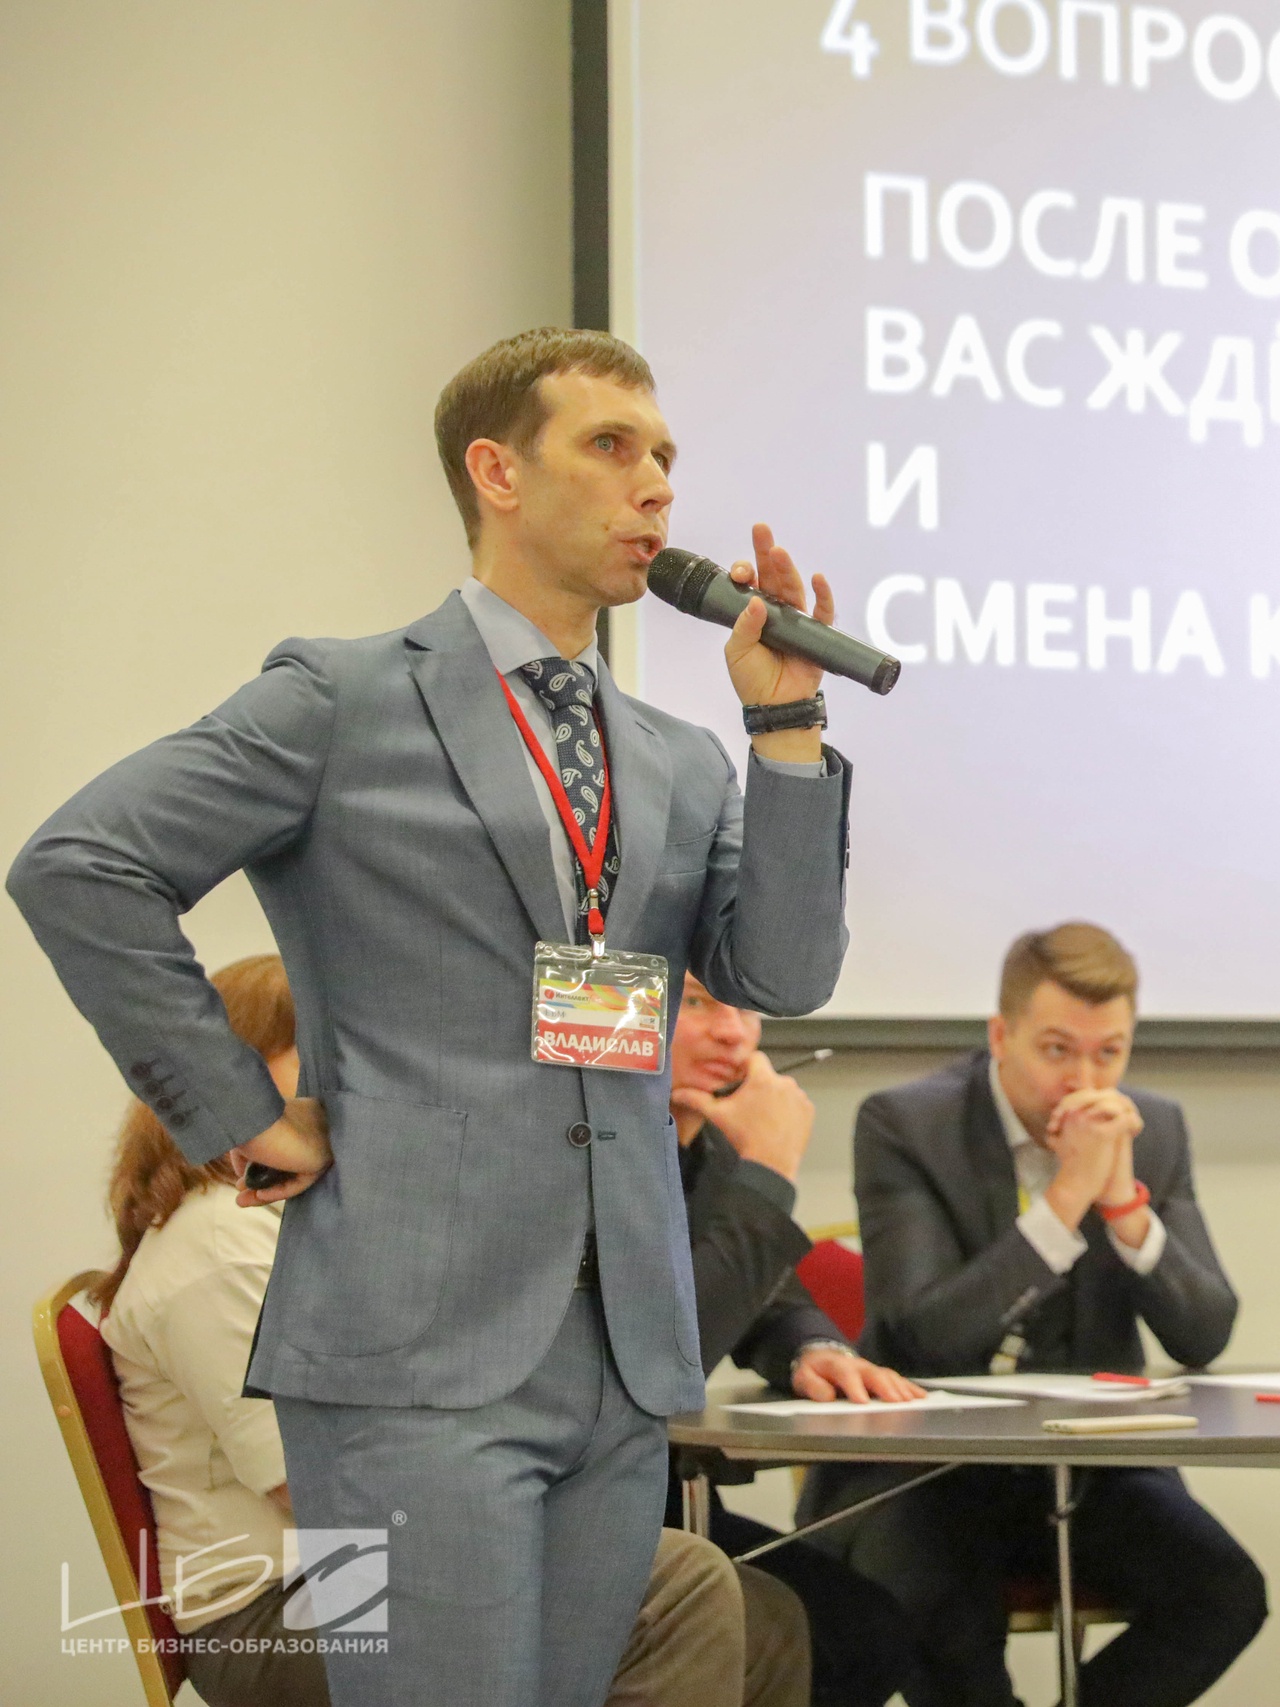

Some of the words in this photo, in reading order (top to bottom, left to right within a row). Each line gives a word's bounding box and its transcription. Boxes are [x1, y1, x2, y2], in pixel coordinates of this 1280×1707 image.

[820, 0, 880, 79] 4
[863, 170, 1209, 291] ПОСЛЕ
[864, 306, 1066, 409] ВАС
[864, 441, 940, 531] И
[864, 573, 1226, 679] СМЕНА
[543, 1031, 654, 1057] ВЛАДИСЛАВ
